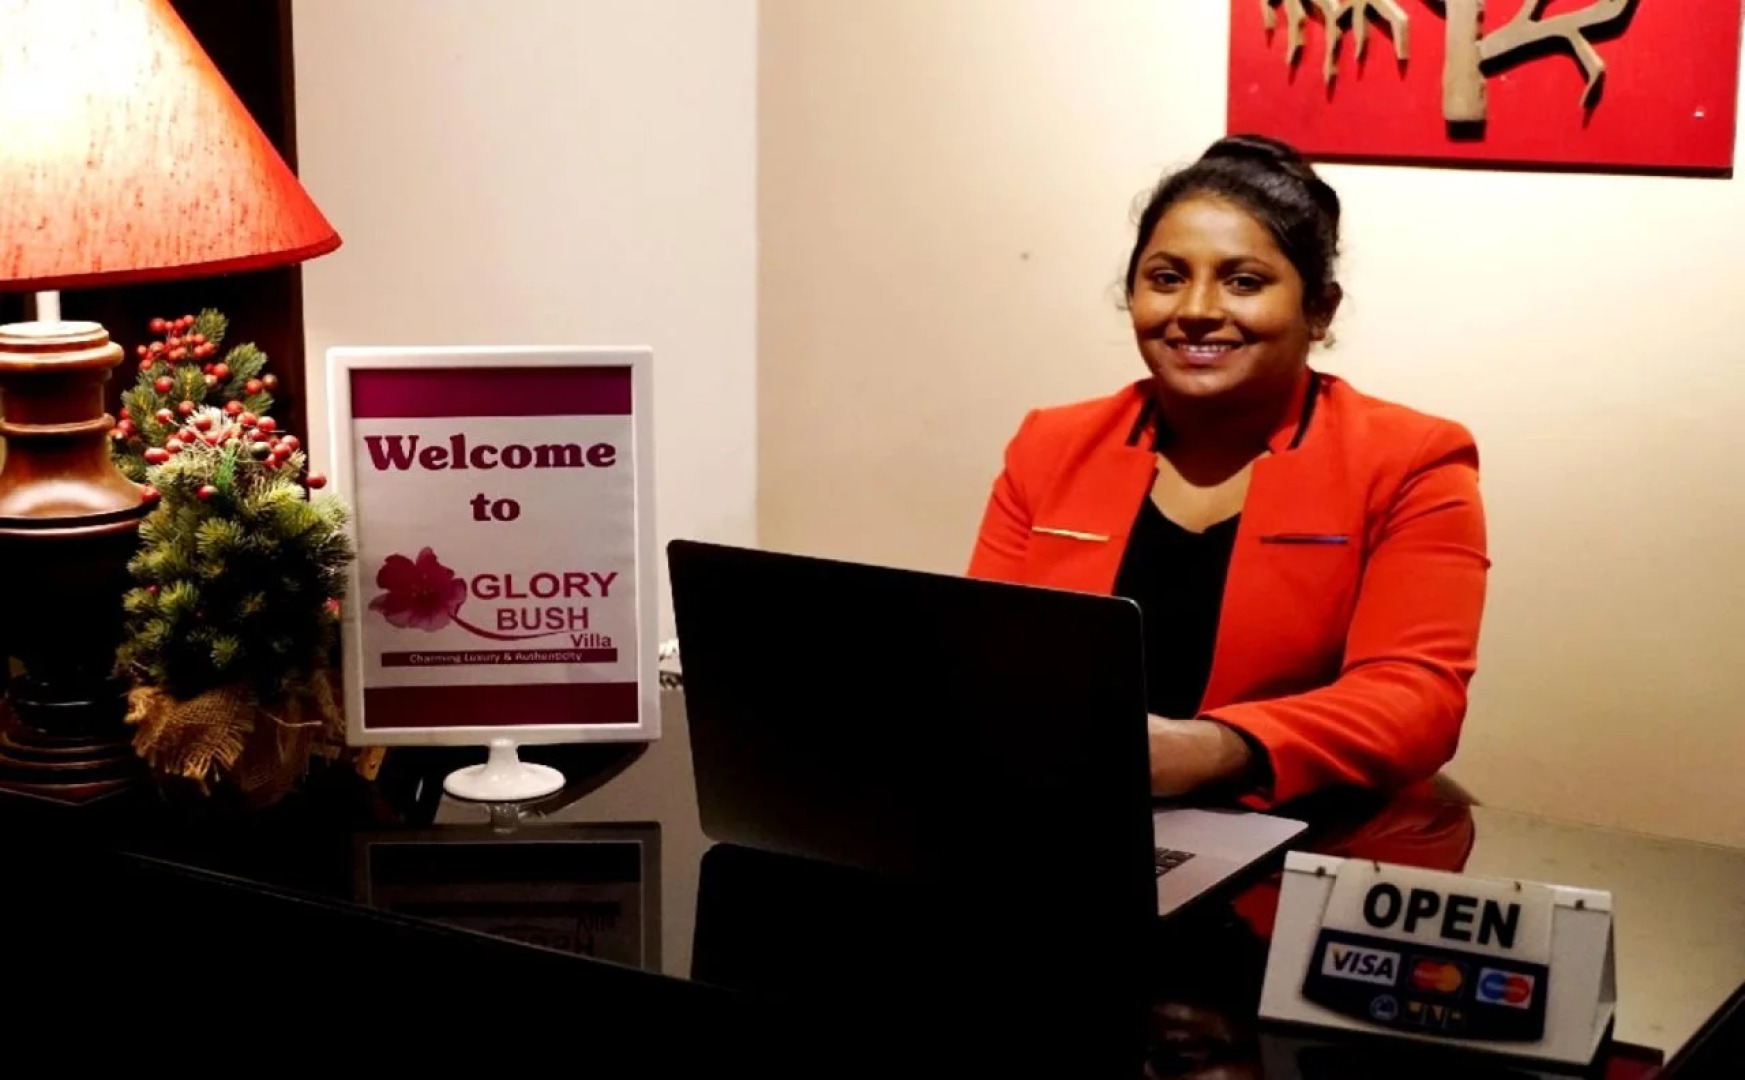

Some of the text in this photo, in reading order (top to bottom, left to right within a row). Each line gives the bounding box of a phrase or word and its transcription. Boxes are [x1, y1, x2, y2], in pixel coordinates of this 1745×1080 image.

[364, 433, 616, 470] Welcome
[470, 493, 521, 522] to
[471, 572, 618, 600] GLORY
[497, 606, 589, 631] BUSH
[570, 634, 612, 648] Villa
[409, 650, 583, 665] Charming Luxury & Authenticity
[1363, 883, 1521, 948] OPEN
[1333, 950, 1394, 979] VISA
